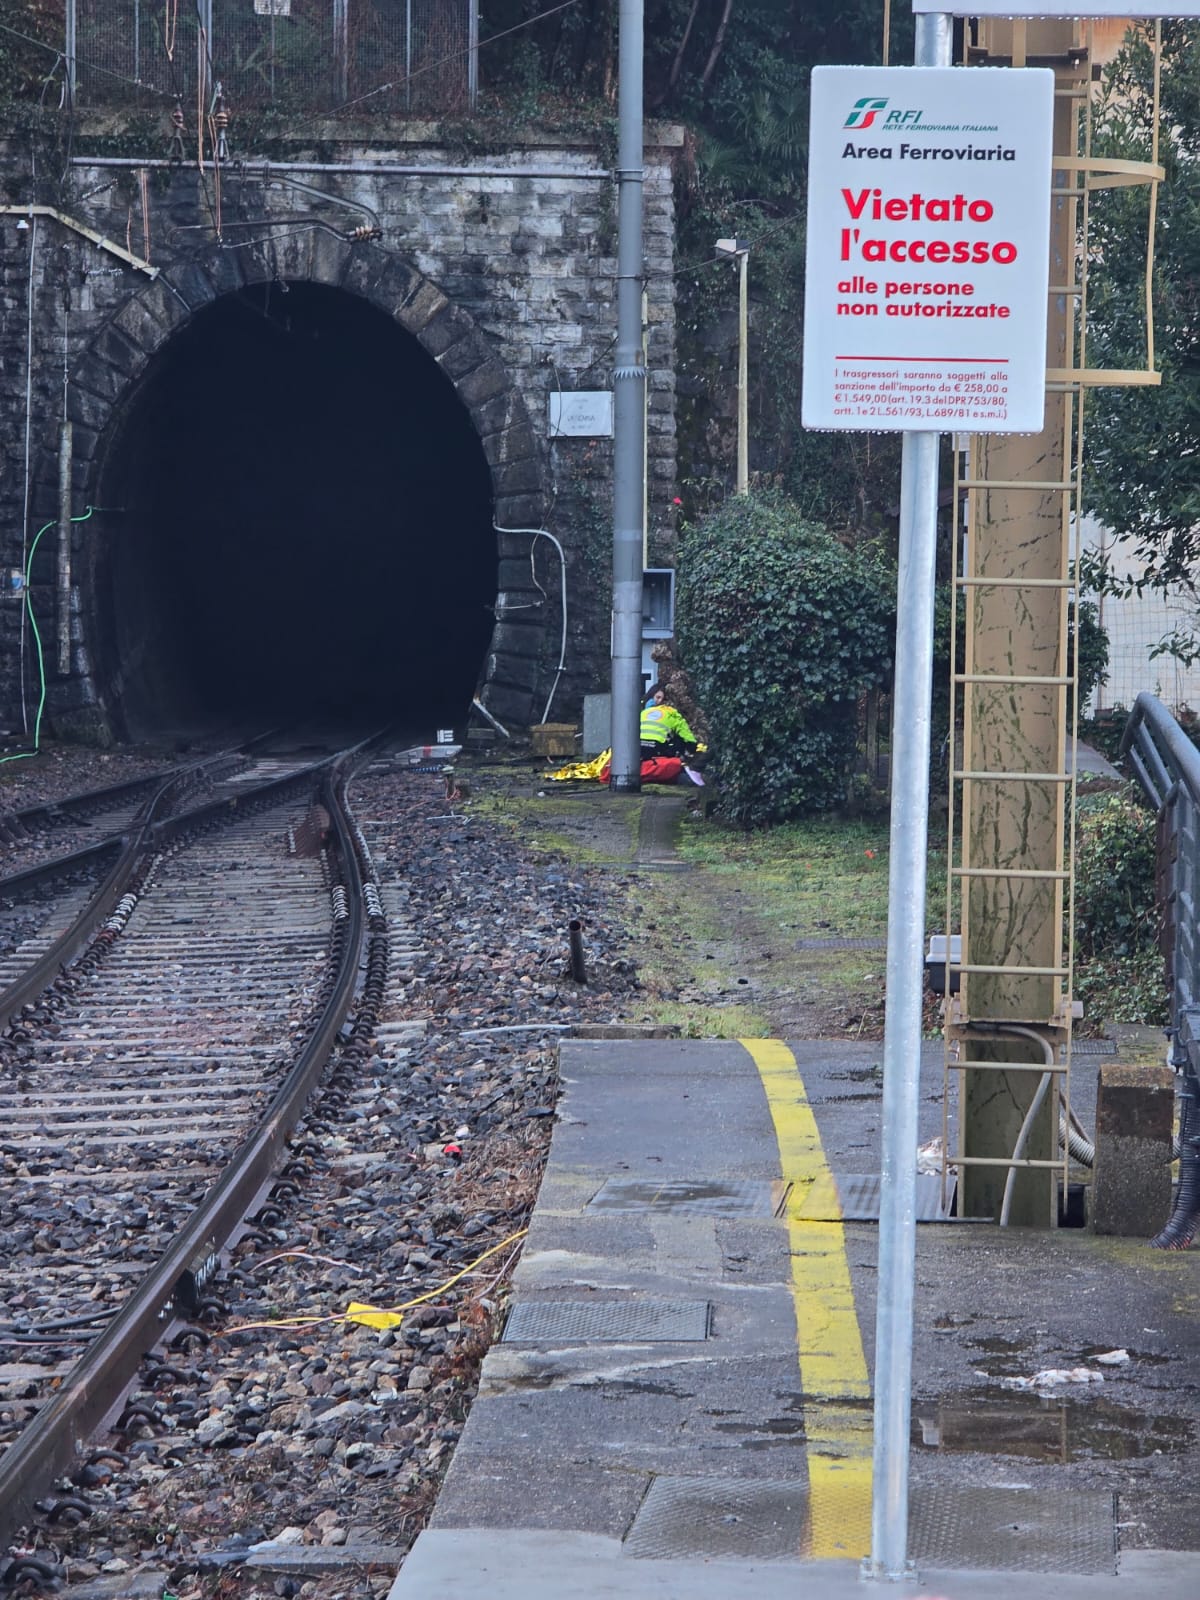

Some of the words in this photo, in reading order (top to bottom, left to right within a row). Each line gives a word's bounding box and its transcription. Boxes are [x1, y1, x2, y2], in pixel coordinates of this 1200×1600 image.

[886, 110, 924, 123] RFI
[842, 143, 892, 159] Area
[900, 144, 1016, 161] Ferroviaria
[841, 188, 994, 222] Vietato
[840, 228, 1018, 264] l'accesso
[837, 276, 878, 293] alle
[885, 281, 974, 298] persone
[837, 303, 878, 315] non
[886, 301, 1011, 318] autorizzate
[843, 369, 899, 380] trasgressori
[904, 371, 942, 379] saranno
[947, 371, 986, 382] soggetti
[990, 371, 1008, 381] alla
[835, 381, 876, 391] sanzione
[879, 381, 936, 393] dell'importo
[939, 382, 951, 392] da
[954, 383, 961, 392] €
[964, 383, 999, 394] 258,00
[835, 393, 842, 403] €
[834, 407, 854, 416] artt.
